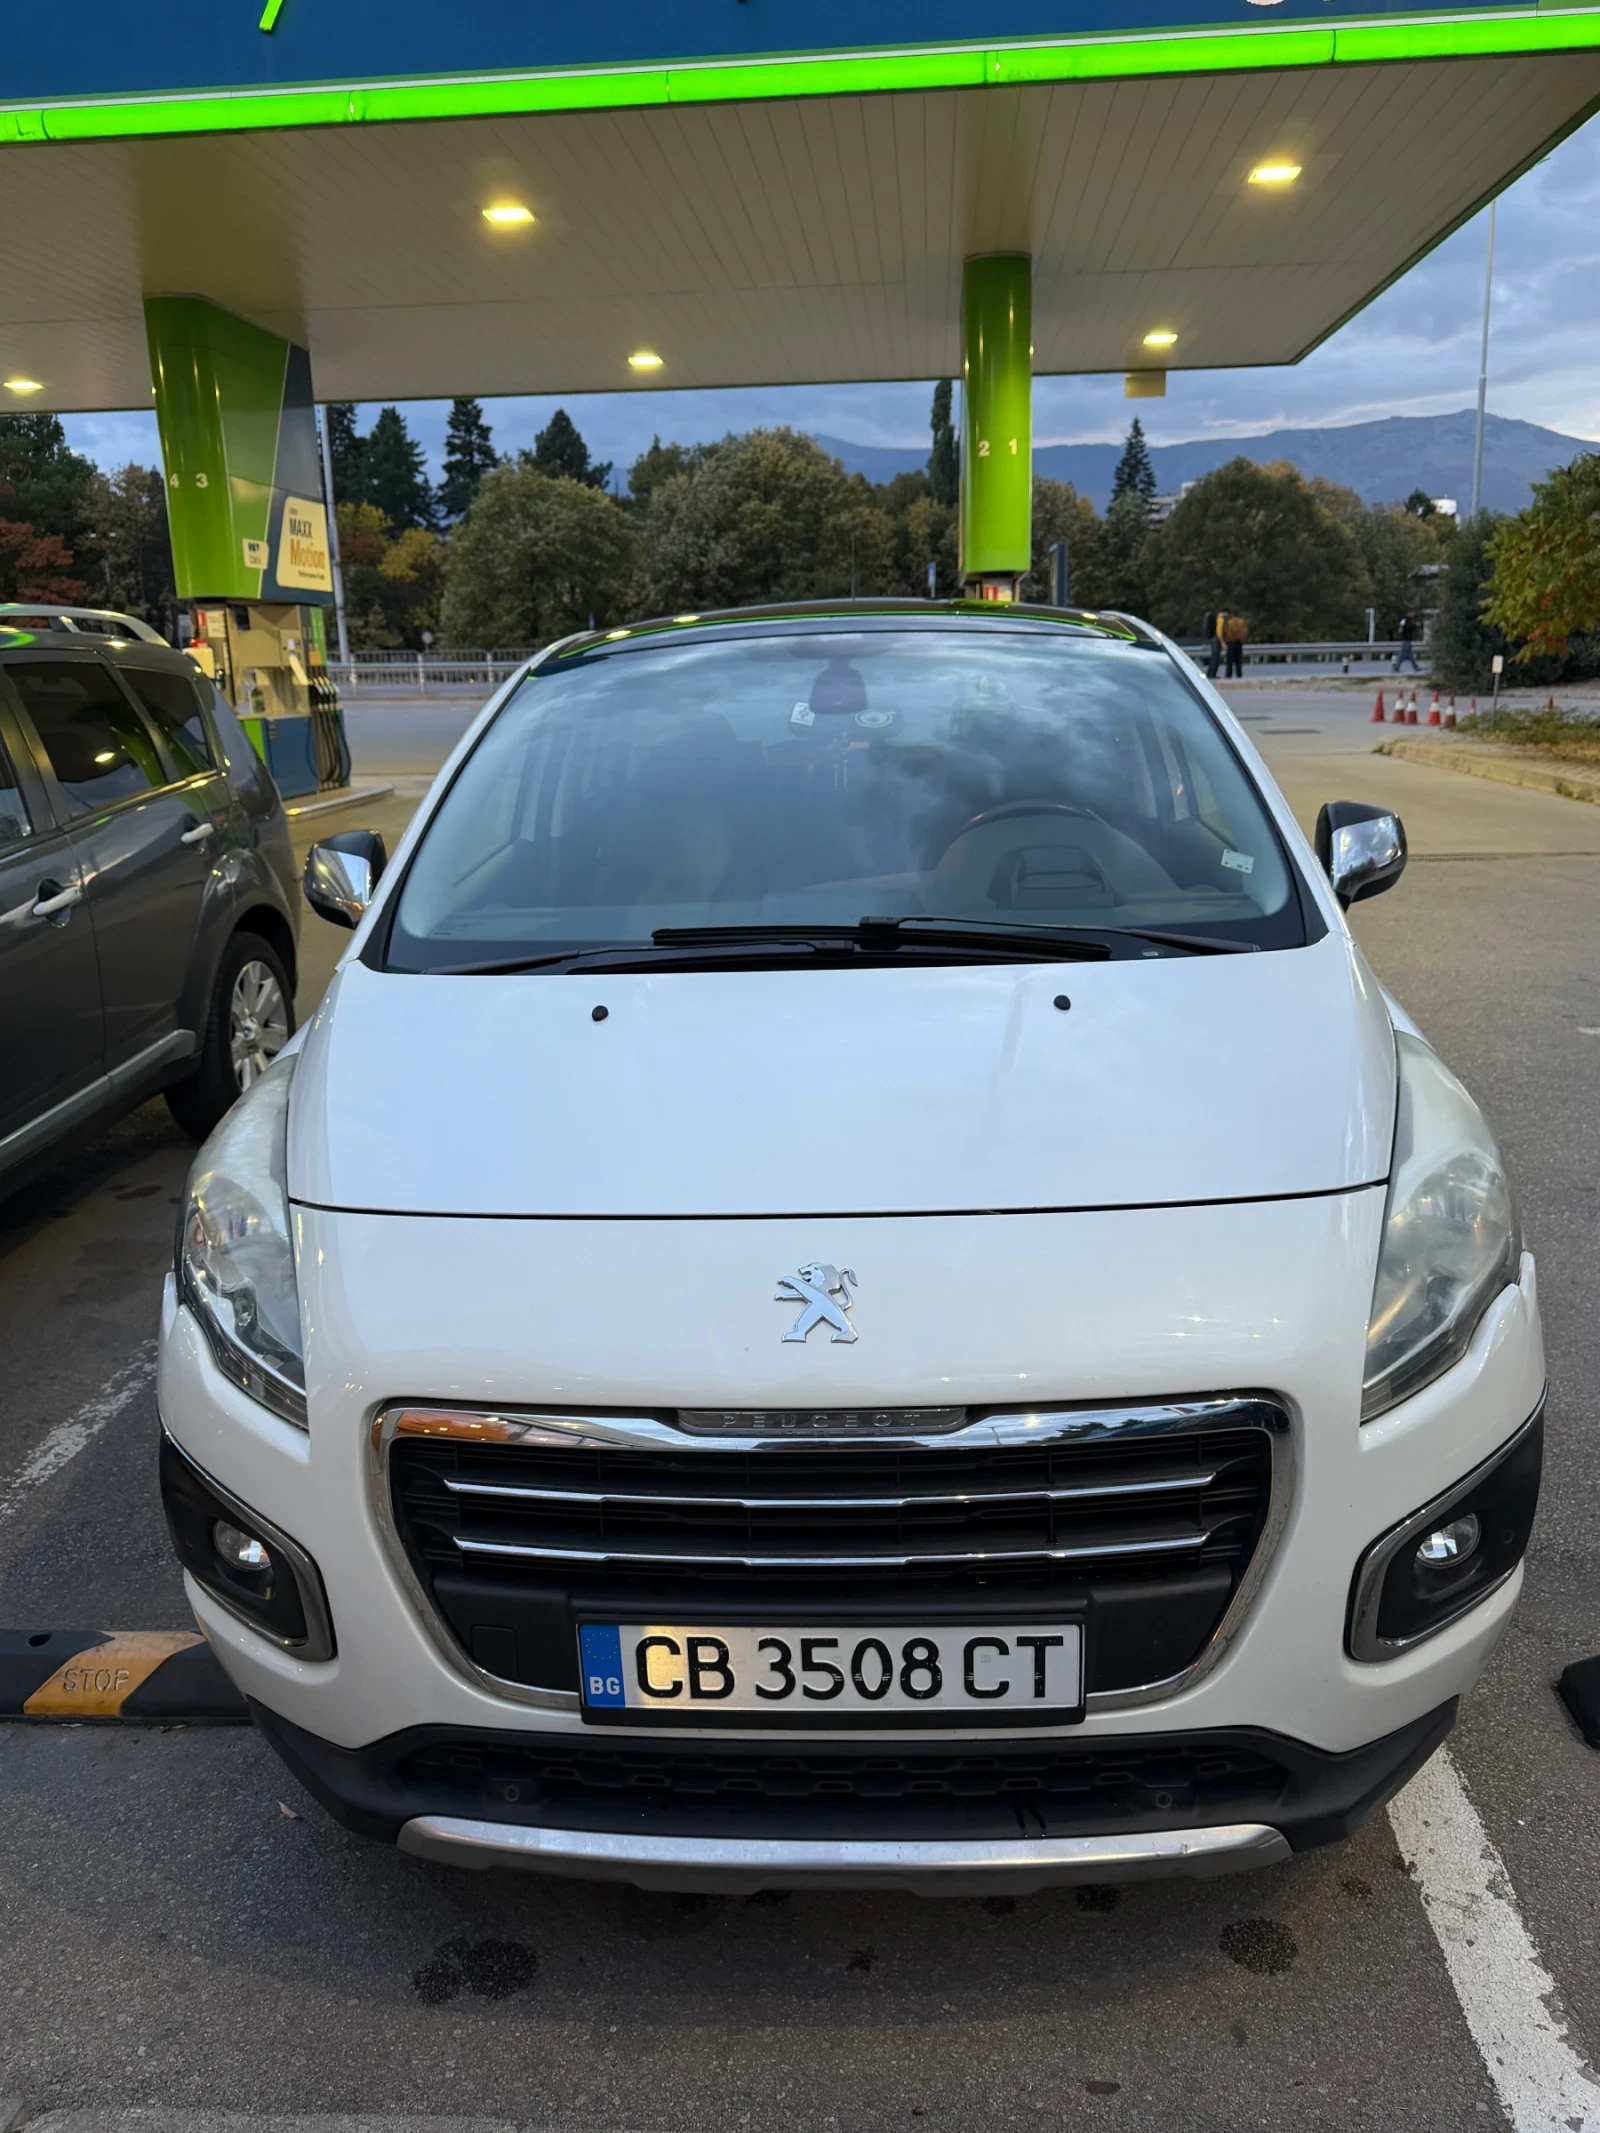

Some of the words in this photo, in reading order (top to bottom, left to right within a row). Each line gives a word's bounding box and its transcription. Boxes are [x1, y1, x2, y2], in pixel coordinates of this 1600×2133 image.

[978, 440, 990, 457] 2
[1008, 438, 1017, 455] 1
[169, 473, 180, 489] 4
[195, 472, 208, 489] 3
[289, 517, 313, 539] MAXX
[290, 538, 326, 570] Motion
[635, 1636, 735, 1699] CB
[755, 1637, 943, 1699] 3508
[963, 1636, 1064, 1699] CT
[63, 1668, 130, 1692] STOP
[589, 1676, 620, 1695] BG
